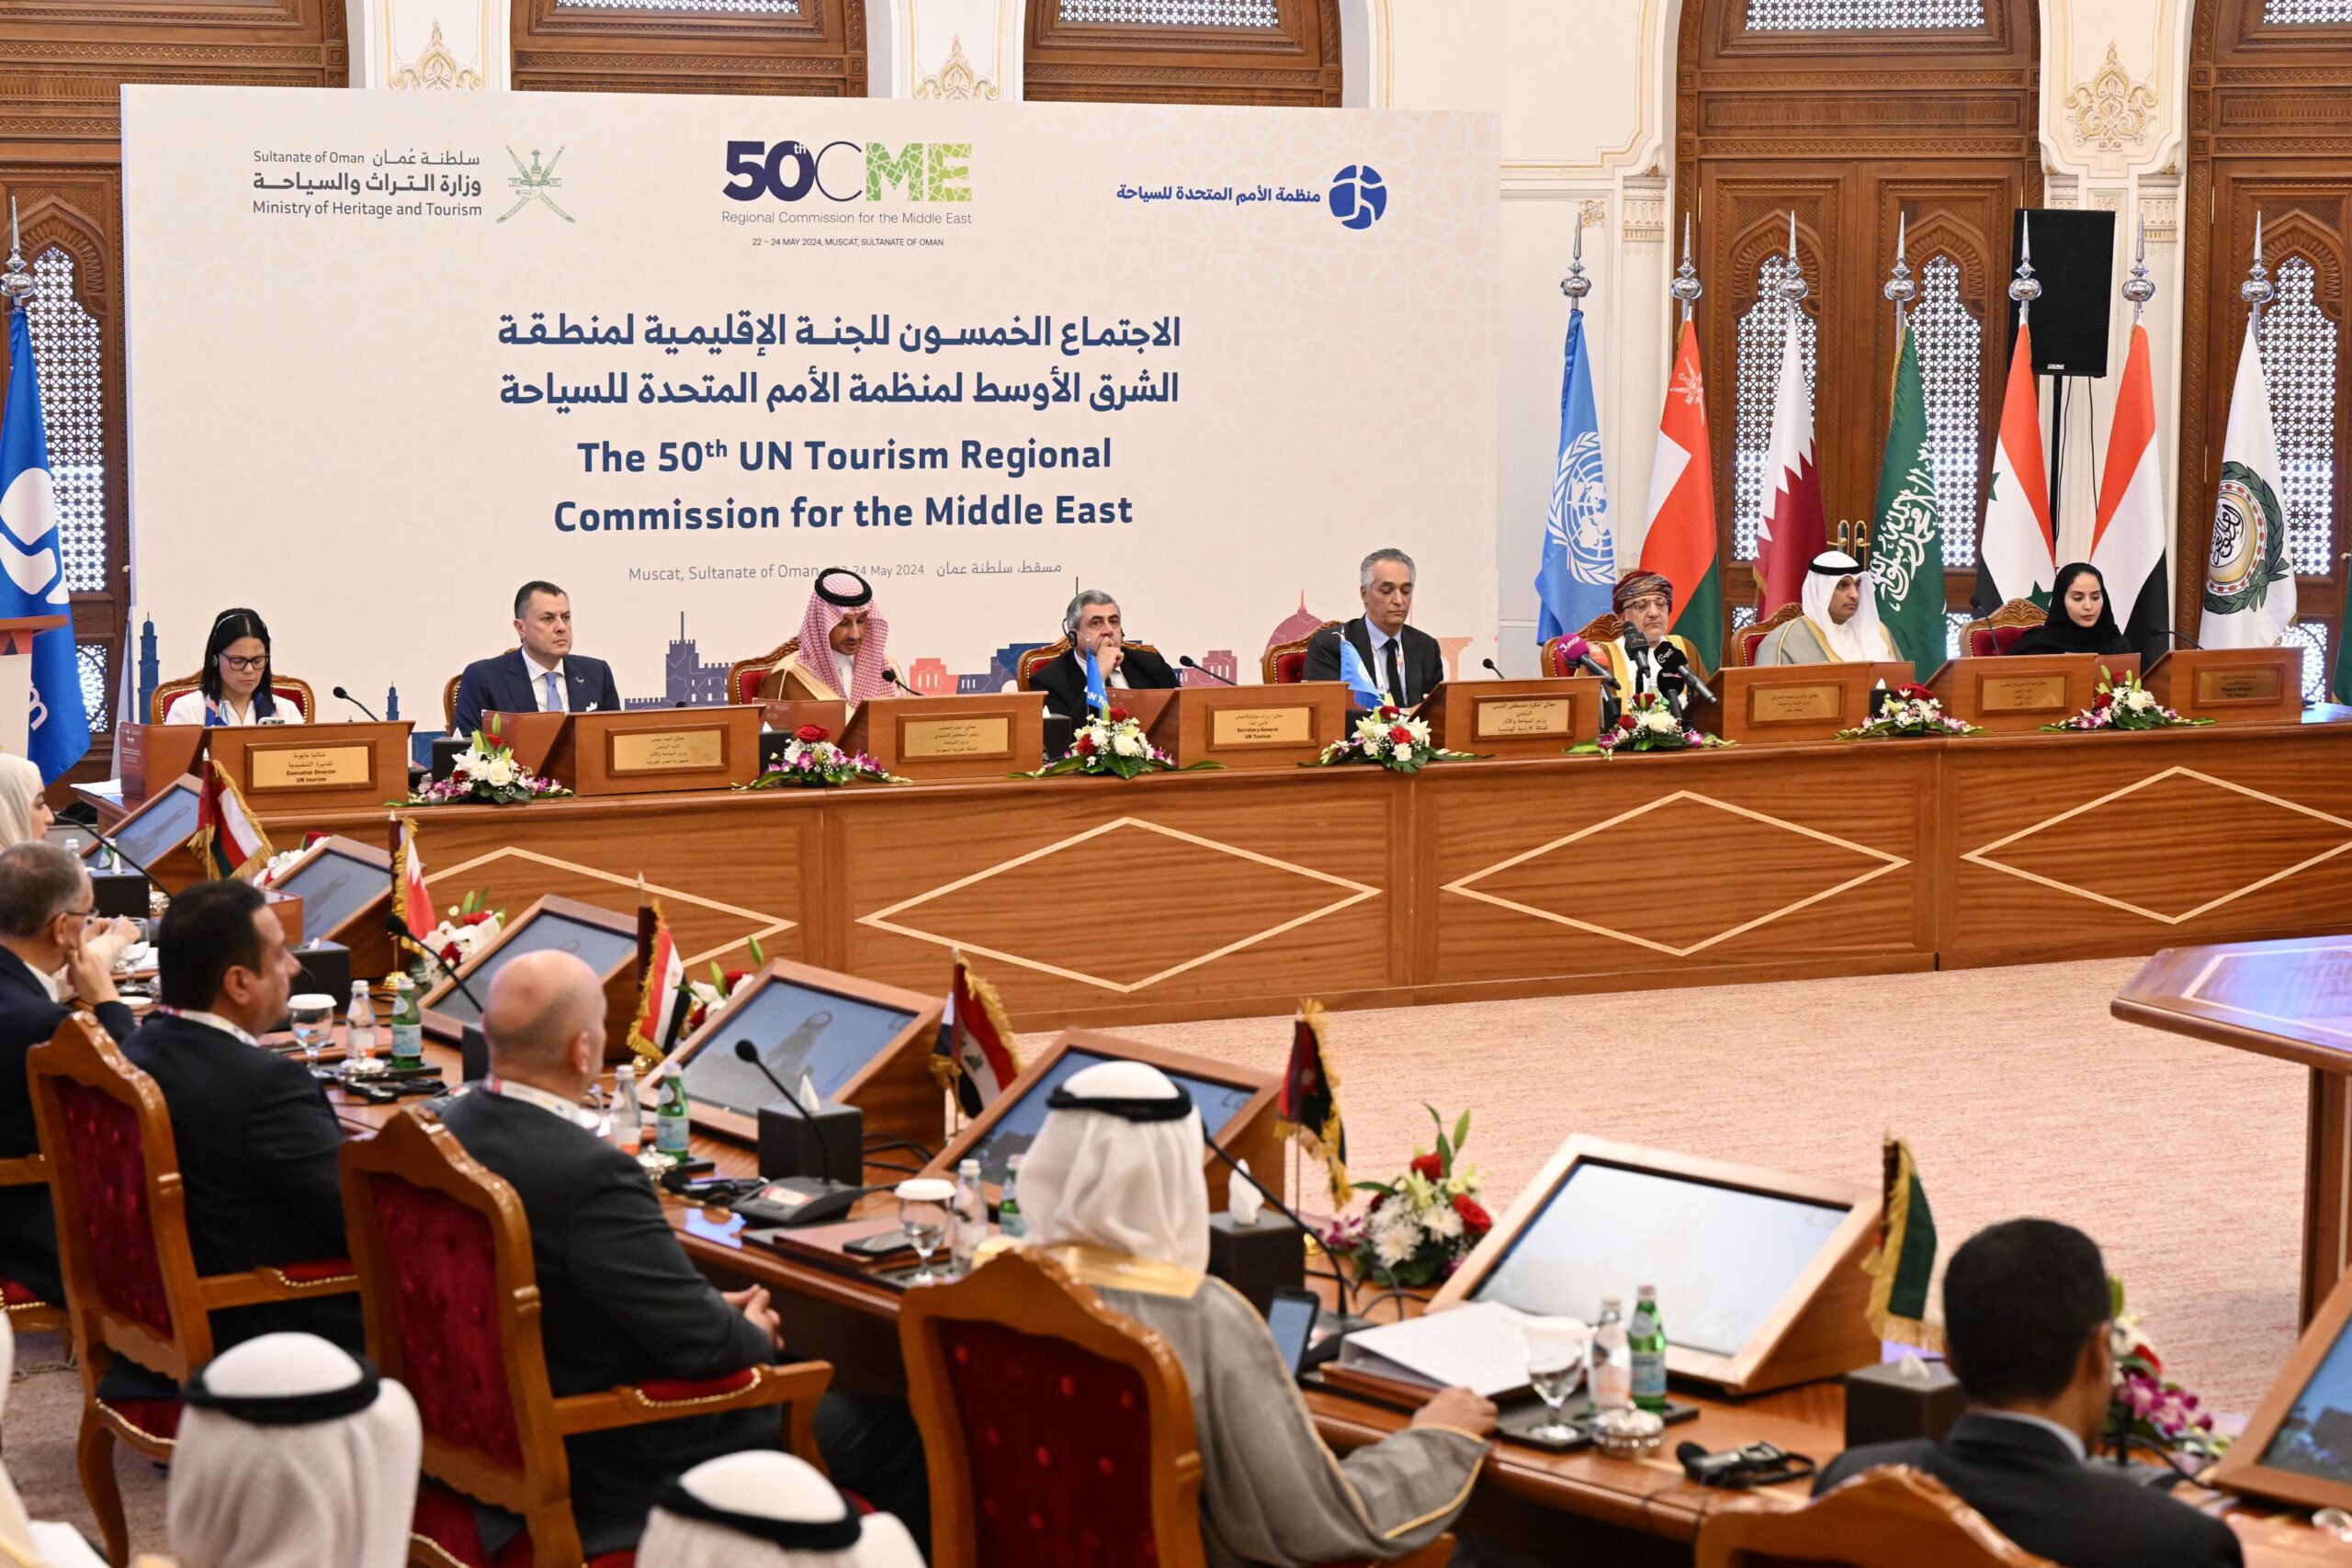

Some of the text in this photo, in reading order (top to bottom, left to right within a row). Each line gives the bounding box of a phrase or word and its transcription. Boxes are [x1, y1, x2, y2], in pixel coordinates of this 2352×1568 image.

[254, 151, 364, 163] Sultanate of Oman
[421, 151, 480, 164] سلطنة
[254, 172, 481, 197] وزارة التراث والسياحة
[1117, 185, 1320, 206] منظمة الأمم المتحدة للسياحة
[254, 200, 481, 219] Ministry of Heritage and Tourism
[722, 211, 971, 225] Regional Commission for the Middle East
[499, 310, 1180, 356] الاجتماع الخمسون للجنة الإقليمية لمنطقة
[501, 366, 1178, 414] الشرق الأوسط لمنظمة الأمم المتحدة للسياحة
[578, 441, 645, 472] The
[741, 441, 791, 470] UN
[805, 438, 947, 469] Tourism
[962, 437, 1110, 478] Regional
[555, 494, 1132, 532] Commission for the Middle East
[629, 568, 684, 581] Muscat,
[689, 566, 756, 580] Sultanate
[762, 564, 775, 578] of
[871, 566, 892, 578] May
[896, 565, 924, 575] 2024
[937, 561, 967, 577] عمان
[972, 560, 1012, 573] سلطنة
